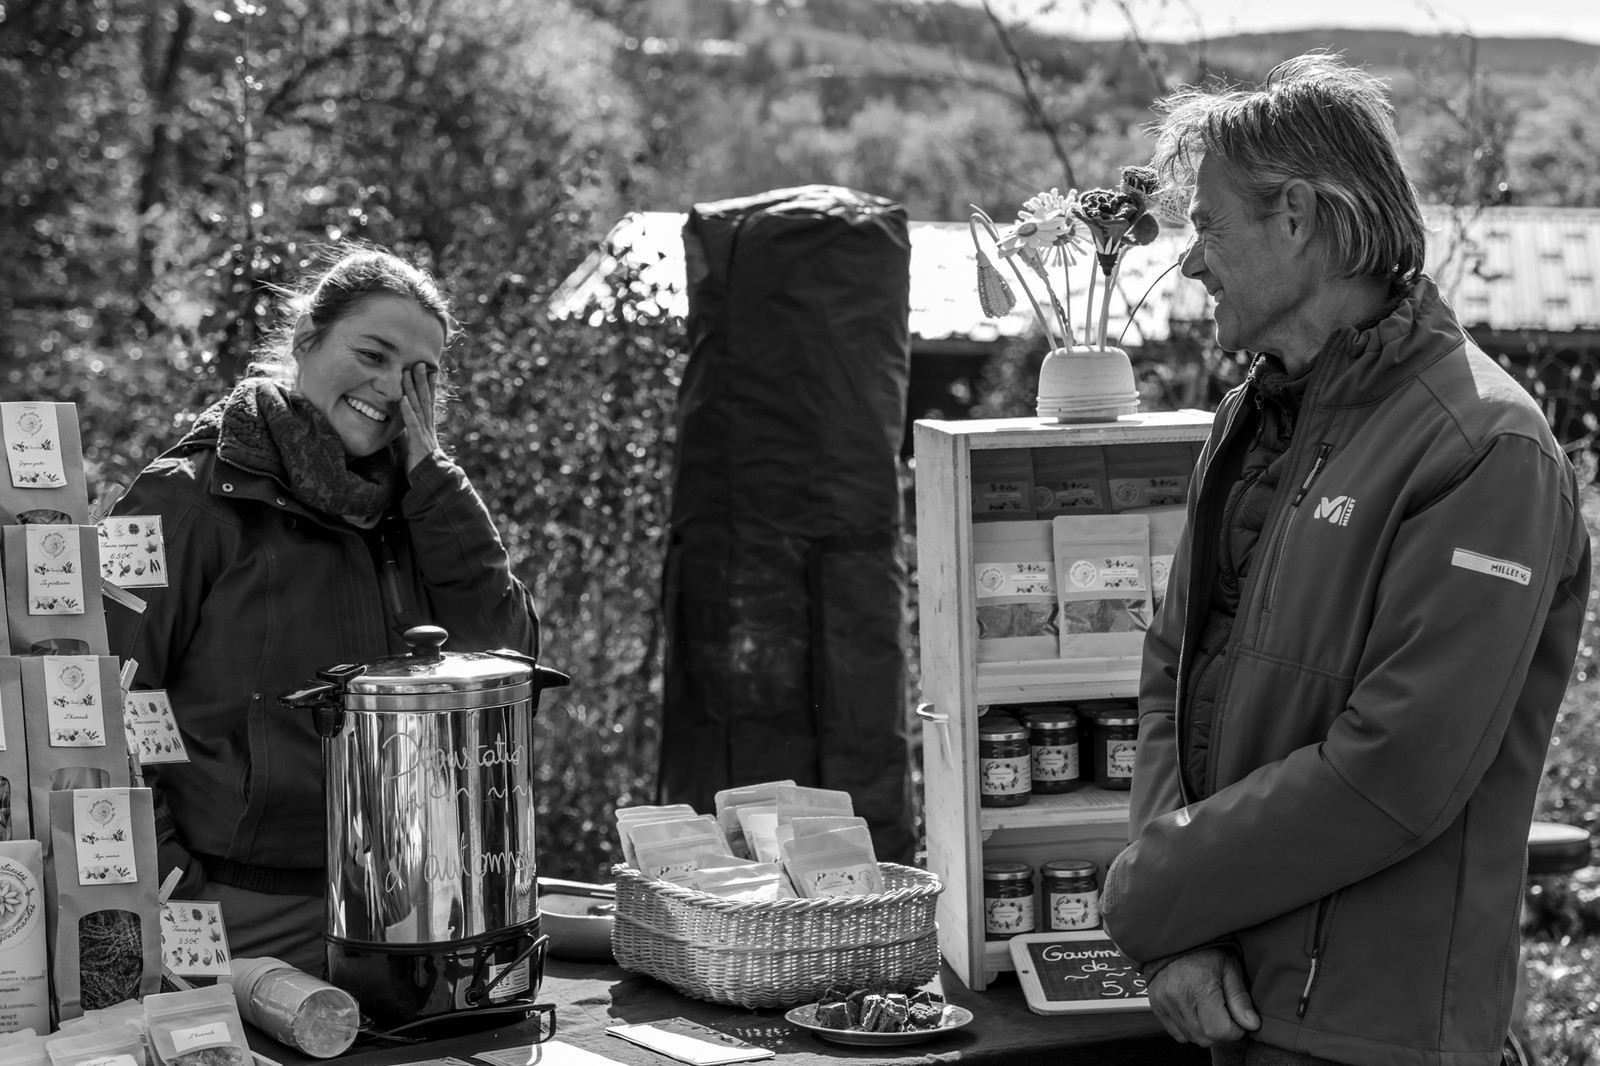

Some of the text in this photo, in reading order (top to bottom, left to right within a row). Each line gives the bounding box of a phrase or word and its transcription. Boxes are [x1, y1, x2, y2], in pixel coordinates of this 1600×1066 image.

[1342, 498, 1356, 527] MILLET
[1490, 564, 1520, 578] MILLET
[1081, 959, 1118, 973] de
